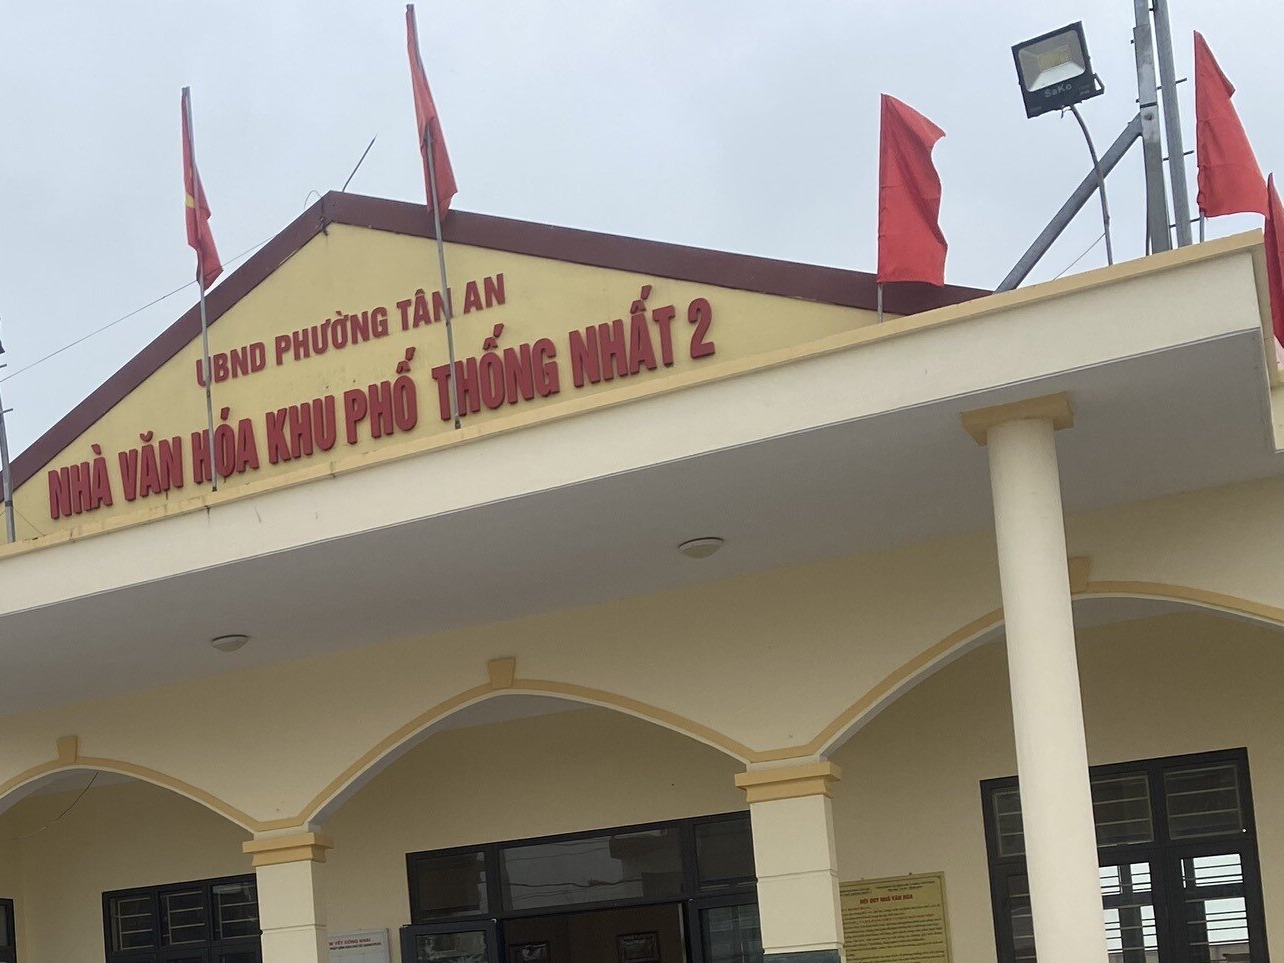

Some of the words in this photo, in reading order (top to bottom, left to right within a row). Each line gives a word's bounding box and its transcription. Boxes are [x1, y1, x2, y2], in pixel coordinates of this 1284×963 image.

[48, 435, 111, 519] NHÀ
[118, 432, 184, 501] VĂN
[191, 406, 260, 485] HÓA
[266, 397, 337, 464] KHU
[343, 346, 418, 444] PHỐ
[431, 323, 560, 421] THỐNG
[569, 286, 677, 389] NHẤT
[686, 297, 716, 358] 2
[196, 341, 266, 387] UBND
[274, 306, 389, 365] PHƯỜNG
[396, 288, 453, 331] TÂN
[463, 273, 506, 314] AN
